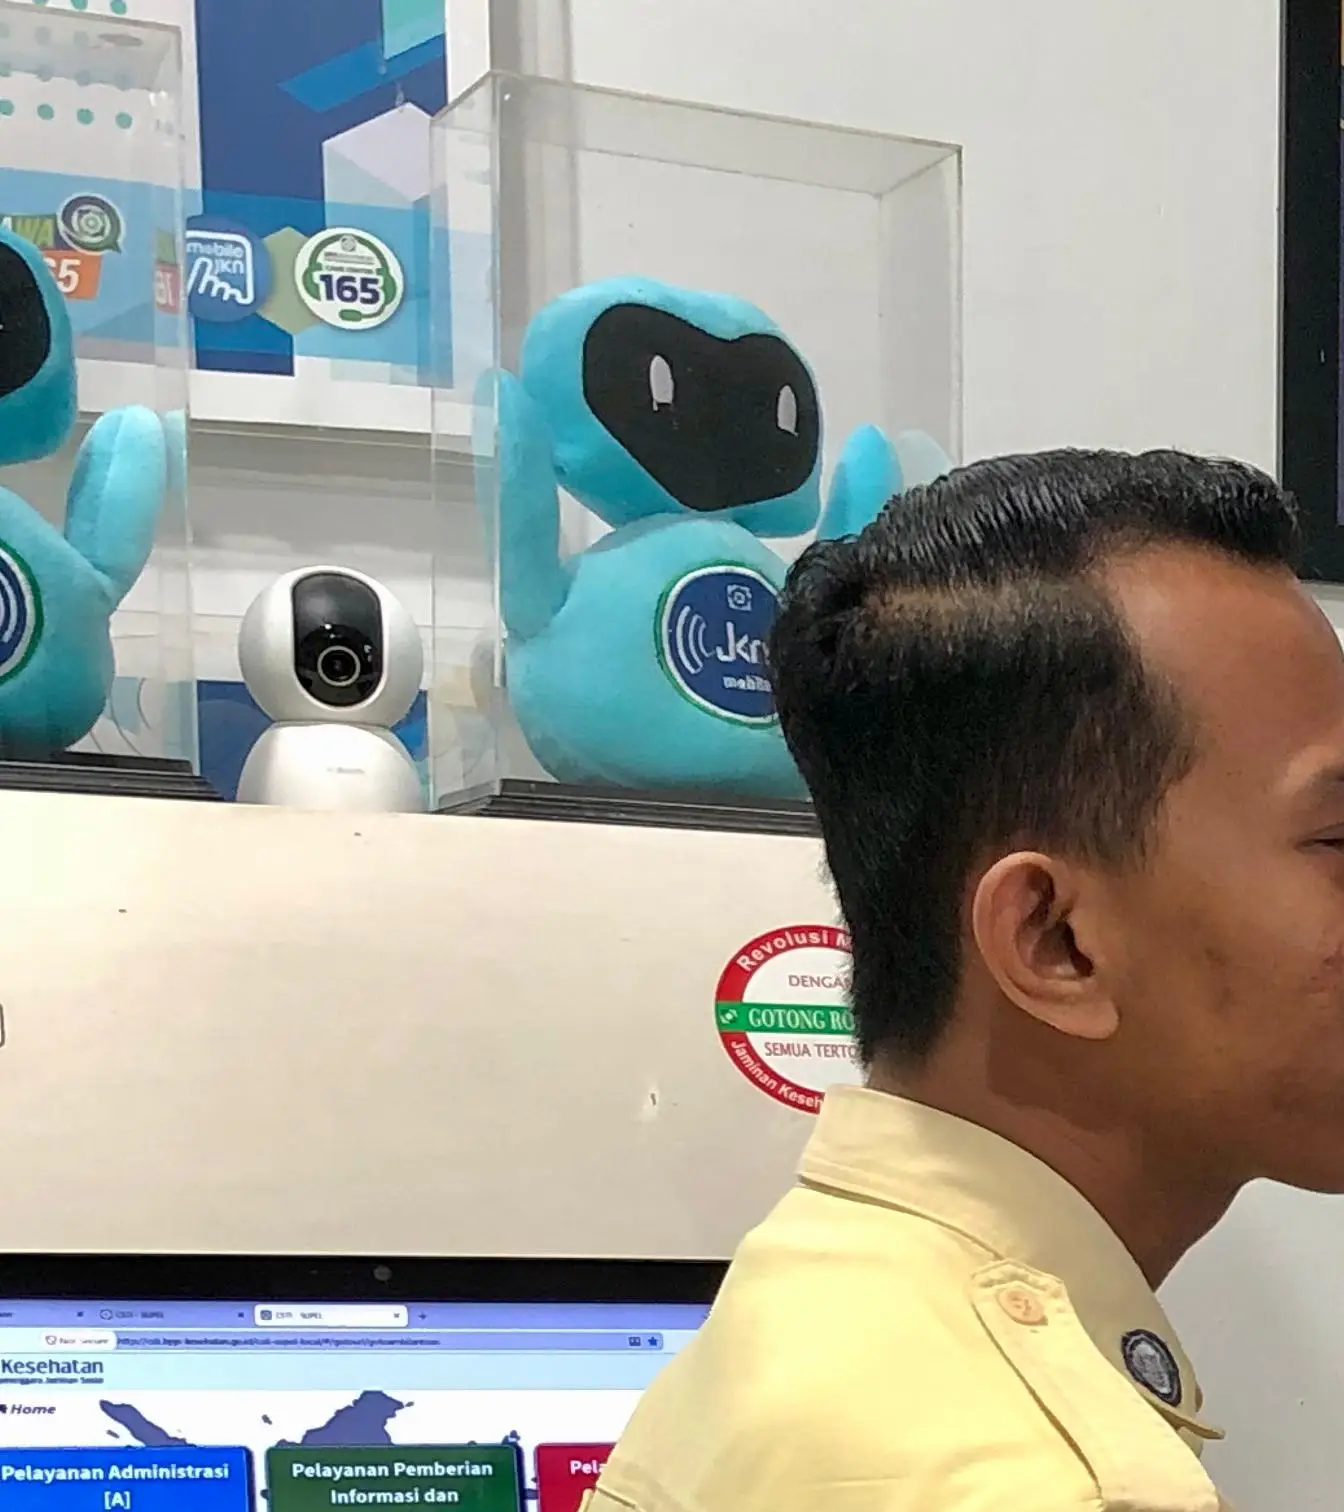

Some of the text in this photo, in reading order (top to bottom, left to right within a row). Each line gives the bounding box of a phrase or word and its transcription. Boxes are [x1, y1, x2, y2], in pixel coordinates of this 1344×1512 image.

[319, 273, 380, 305] 165
[736, 929, 829, 972] Revolusi
[749, 1007, 826, 1032] GOTONG
[764, 1041, 811, 1058] SEMUA
[731, 1040, 778, 1091] Jaminan
[1, 1358, 104, 1375] Kesehatan
[10, 1403, 57, 1415] Home
[1, 1462, 230, 1486] Pelayanan Administrasi
[291, 1461, 389, 1483] Pelayanan
[393, 1459, 494, 1479] Pemberian
[103, 1490, 132, 1511] [A]
[330, 1486, 459, 1505] Informasi dan
